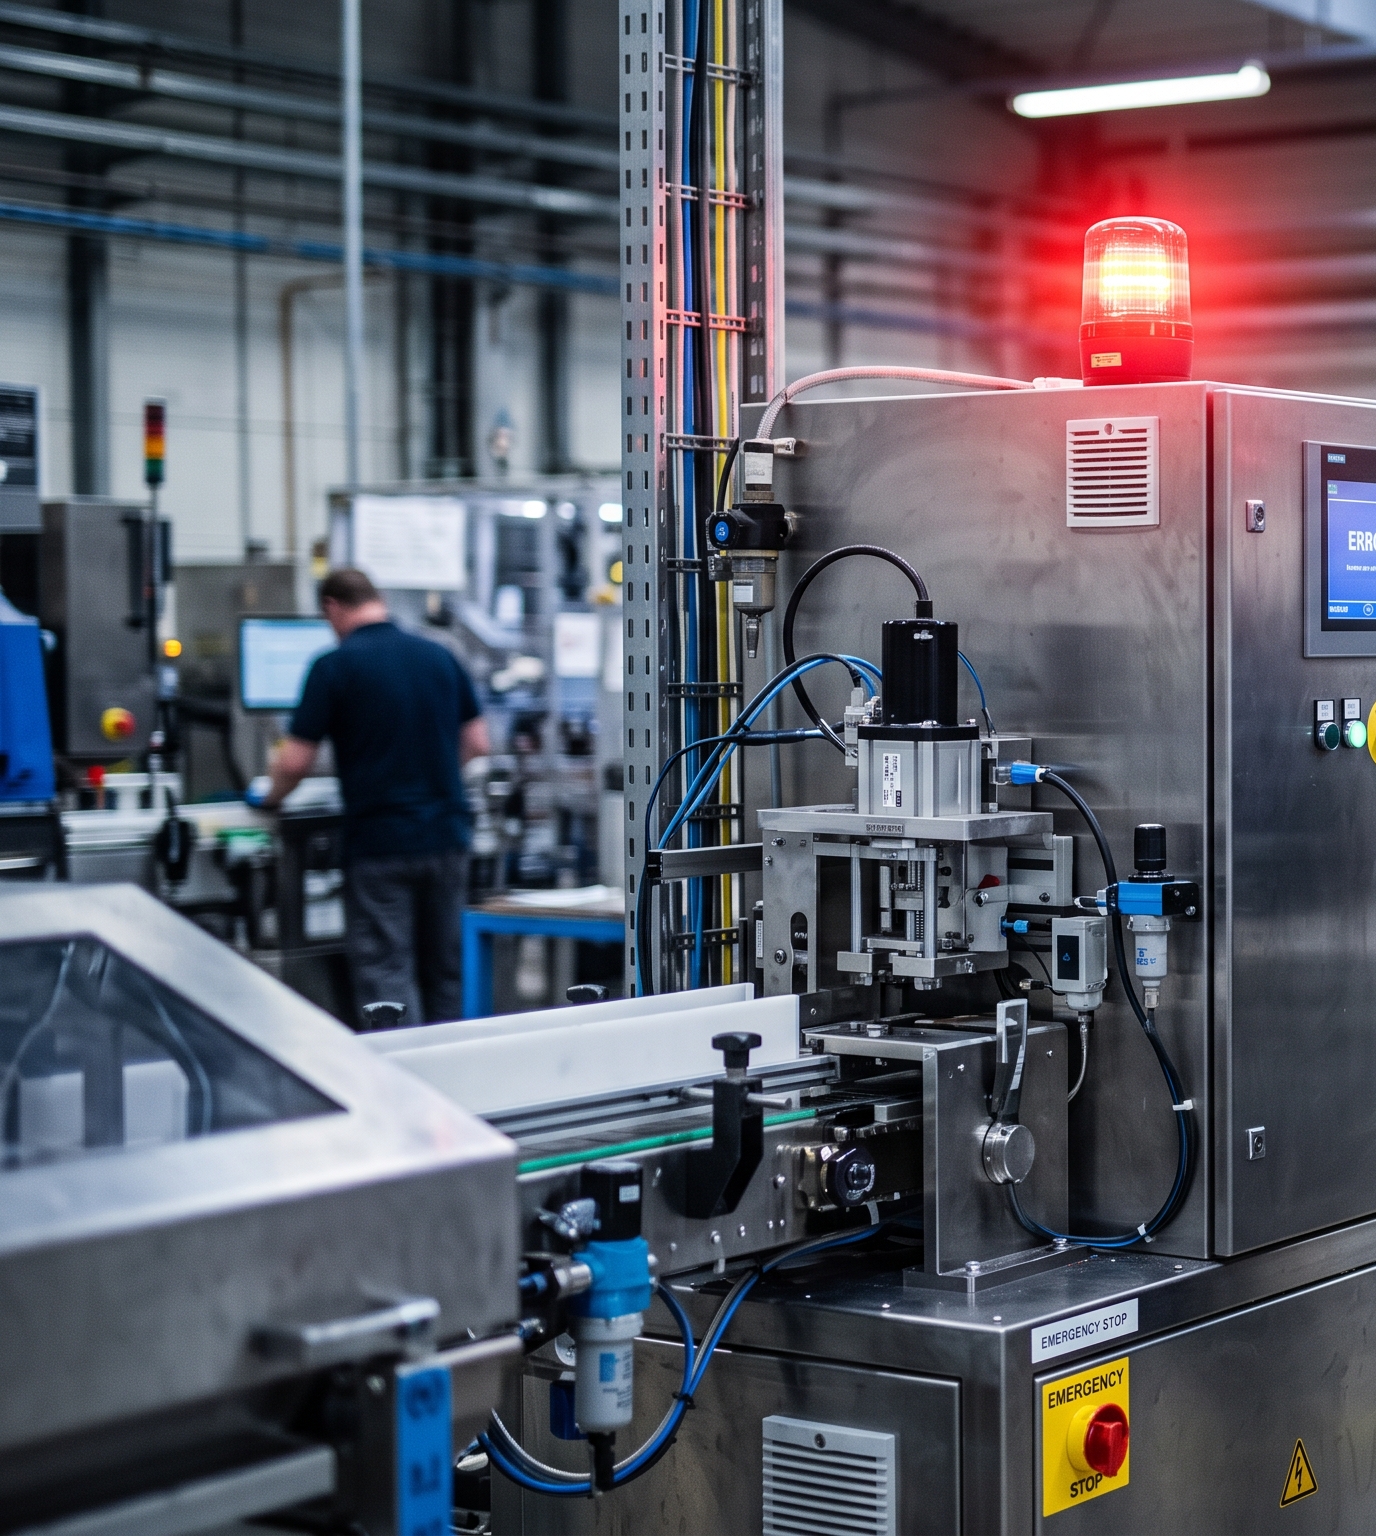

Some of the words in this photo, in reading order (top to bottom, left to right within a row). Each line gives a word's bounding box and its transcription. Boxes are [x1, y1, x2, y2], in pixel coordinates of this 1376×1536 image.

[1041, 1320, 1101, 1350] EMERGENCY
[1102, 1312, 1128, 1331] STOP
[1048, 1368, 1124, 1409] EMERGENCY
[1070, 1472, 1103, 1498] STOP
